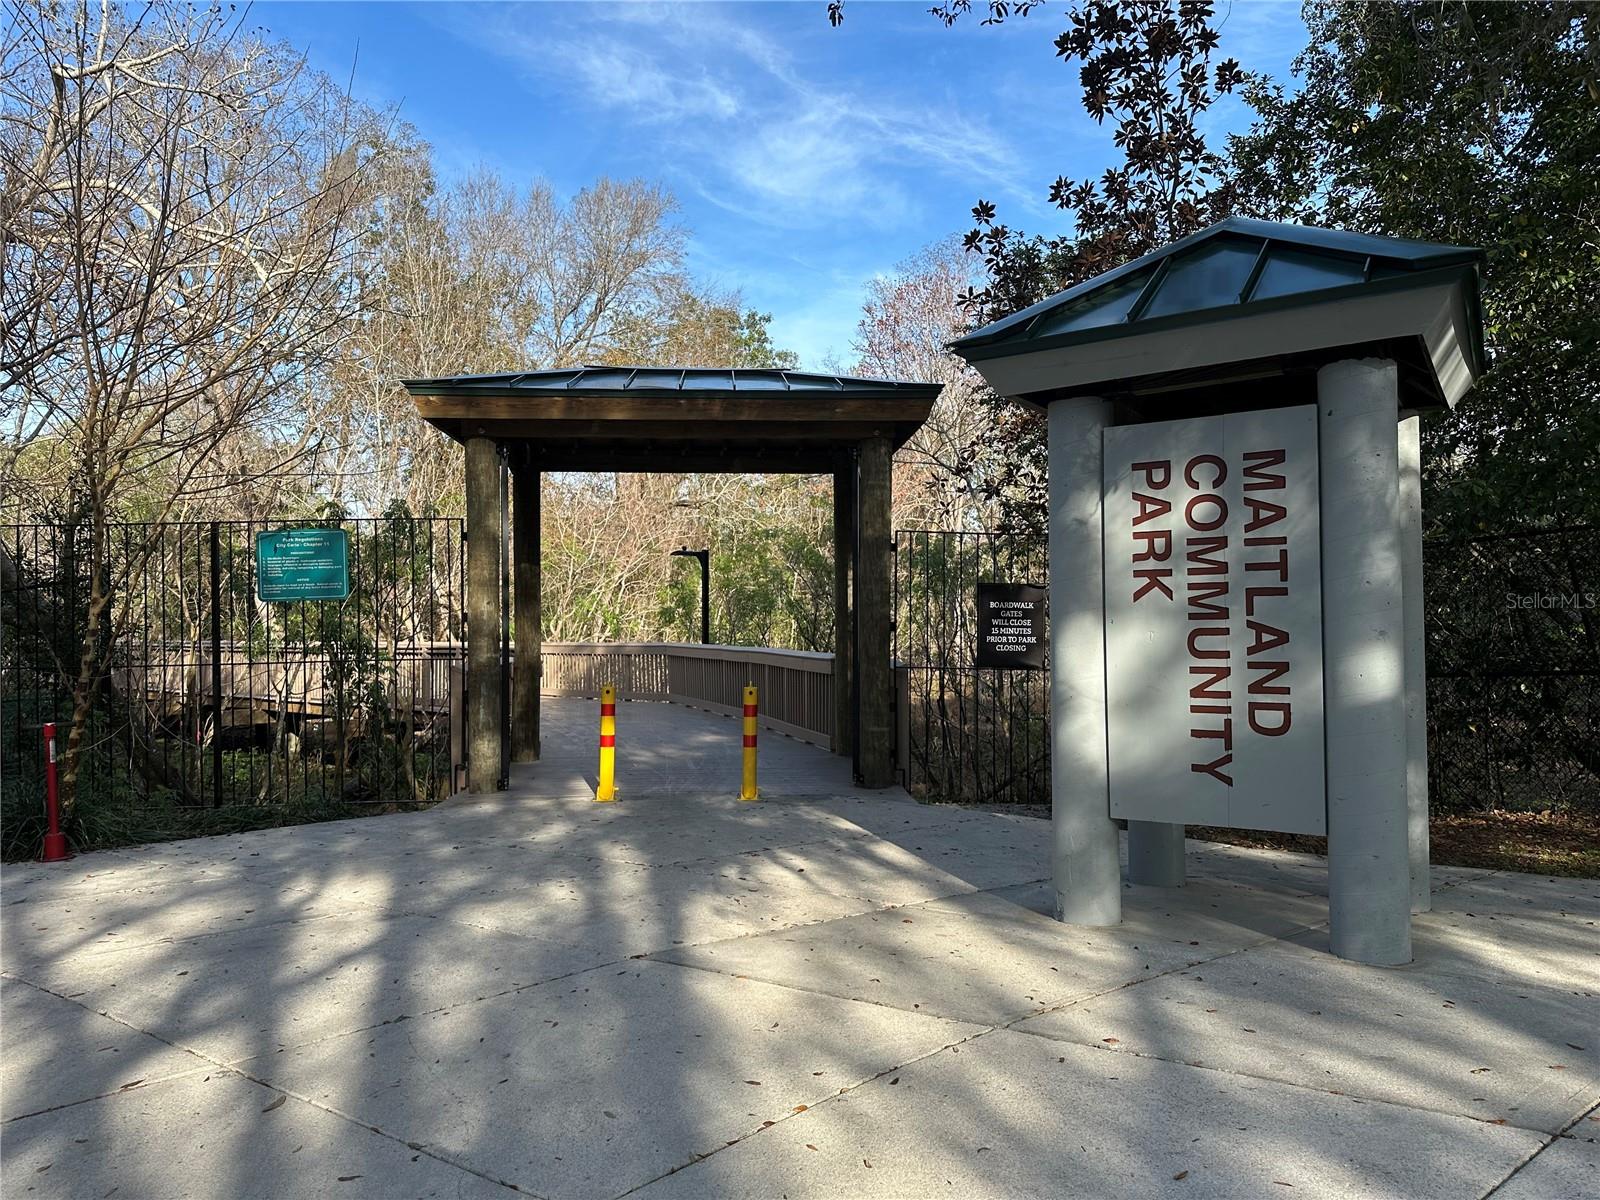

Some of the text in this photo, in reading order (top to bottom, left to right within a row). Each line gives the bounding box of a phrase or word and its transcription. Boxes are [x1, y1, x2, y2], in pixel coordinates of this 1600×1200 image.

[990, 601, 1034, 609] BOARDWALK
[1131, 460, 1174, 603] PARK
[1184, 454, 1233, 787] COMMUNITY
[1243, 449, 1292, 737] MAITLAND
